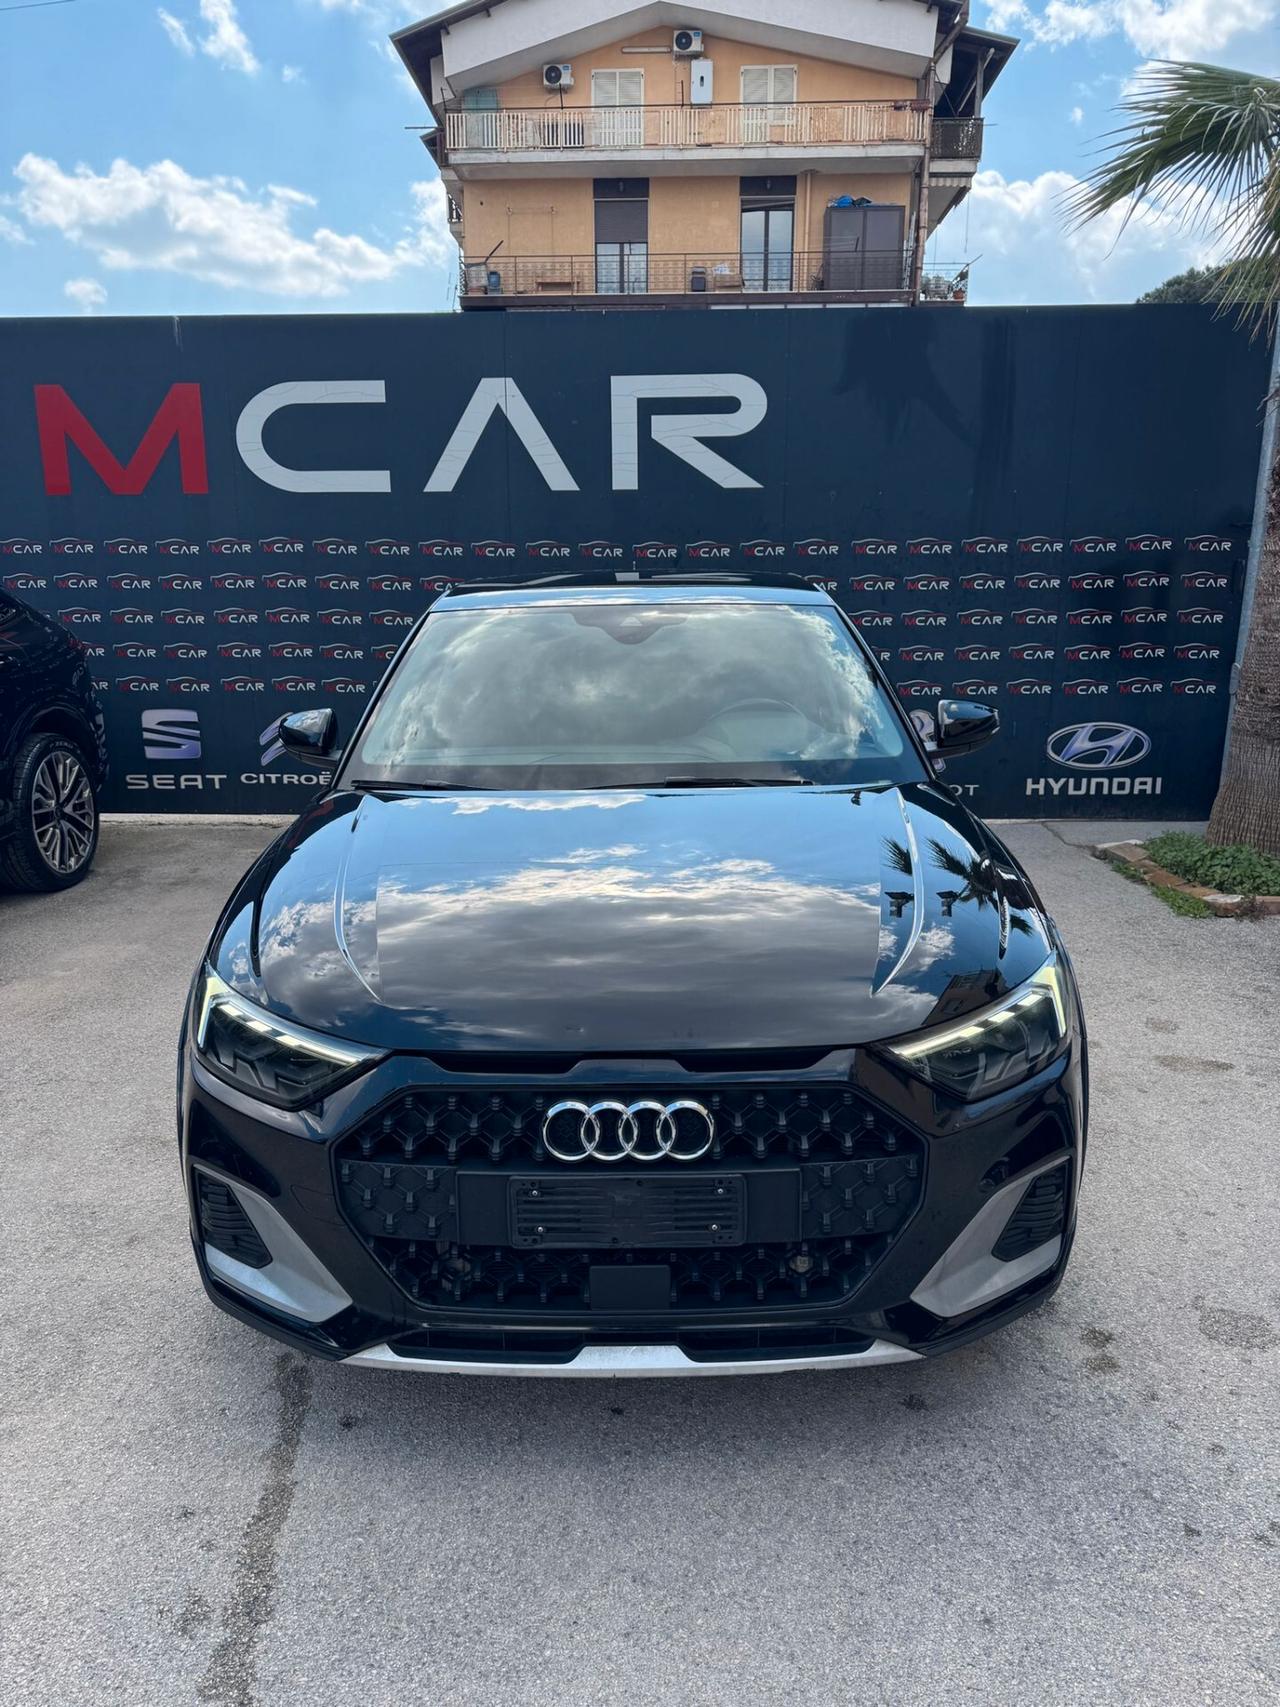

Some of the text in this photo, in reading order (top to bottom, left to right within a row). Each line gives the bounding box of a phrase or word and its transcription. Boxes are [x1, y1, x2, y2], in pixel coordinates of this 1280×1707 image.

[34, 373, 768, 496] MCAR
[3, 543, 42, 554] MCAR
[54, 543, 93, 554] MCAR
[108, 544, 147, 554] MCAR
[160, 544, 199, 554] MCAR
[211, 543, 251, 554] MCAR
[263, 542, 303, 553] MCAR
[317, 544, 357, 554] MCAR
[370, 544, 410, 556] MCAR
[422, 545, 463, 556] MCAR
[475, 545, 515, 557] MCAR
[744, 545, 784, 556] MCAR
[797, 544, 838, 555] MCAR
[856, 543, 897, 555] MCAR
[910, 543, 952, 554] MCAR
[966, 542, 1007, 553] MCAR
[1020, 541, 1063, 553] MCAR
[1074, 541, 1116, 553] MCAR
[1129, 540, 1171, 551] MCAR
[1189, 541, 1231, 552] MCAR
[529, 546, 570, 557] MCAR
[582, 546, 622, 558] MCAR
[636, 547, 677, 558] MCAR
[689, 546, 730, 558] MCAR
[7, 578, 46, 589] MCAR
[58, 577, 97, 588] MCAR
[112, 578, 150, 589] MCAR
[162, 579, 202, 590] MCAR
[214, 578, 254, 589] MCAR
[266, 578, 306, 588] MCAR
[319, 579, 359, 590] MCAR
[372, 580, 411, 591] MCAR
[424, 581, 463, 591] MCA
[854, 580, 895, 591] MCAR
[908, 579, 949, 590] MCAR
[963, 578, 1005, 589] MCAR
[1018, 577, 1060, 589] MCAR
[1072, 578, 1114, 589] MCAR
[1127, 576, 1169, 587] MCAR
[1184, 577, 1227, 588] MCAR
[62, 612, 101, 623] MCAR
[114, 613, 153, 624] MCAR
[165, 614, 204, 624] MCAR
[219, 613, 257, 623] MCAR
[270, 612, 309, 623] MCAR
[322, 614, 362, 625] MCAR
[374, 615, 413, 626] MCAR
[905, 615, 946, 626] MCAR
[961, 614, 1003, 625] MCAR
[1015, 613, 1057, 624] MCAR
[1070, 613, 1112, 624] MCAR
[1125, 611, 1167, 623] MCAR
[1181, 612, 1223, 624] MCAR
[117, 647, 156, 658] MCAR
[168, 648, 206, 658] MCAR
[222, 647, 260, 658] MCAR
[273, 647, 312, 657] MCAR
[324, 649, 363, 660] MCAR
[903, 650, 944, 661] MCAR
[958, 650, 1000, 661] MCAR
[1013, 649, 1054, 660] MCAR
[1068, 649, 1110, 660] MCAR
[1122, 647, 1164, 658] MCAR
[1178, 648, 1219, 659] MCAR
[120, 681, 159, 692] MCAR
[170, 682, 209, 692] MCAR
[225, 681, 264, 692] MCAR
[276, 681, 315, 692] MCAR
[326, 682, 365, 693] MCAR
[900, 685, 941, 696] MCAR
[956, 685, 997, 696] MCAR
[1010, 684, 1051, 695] MCAR
[1065, 684, 1108, 695] MCAR
[1120, 682, 1162, 693] MCAR
[1174, 683, 1215, 694] MCAR
[126, 774, 227, 790] SEAT
[240, 771, 332, 785] CITROË
[1025, 776, 1162, 796] HYUNDAI
